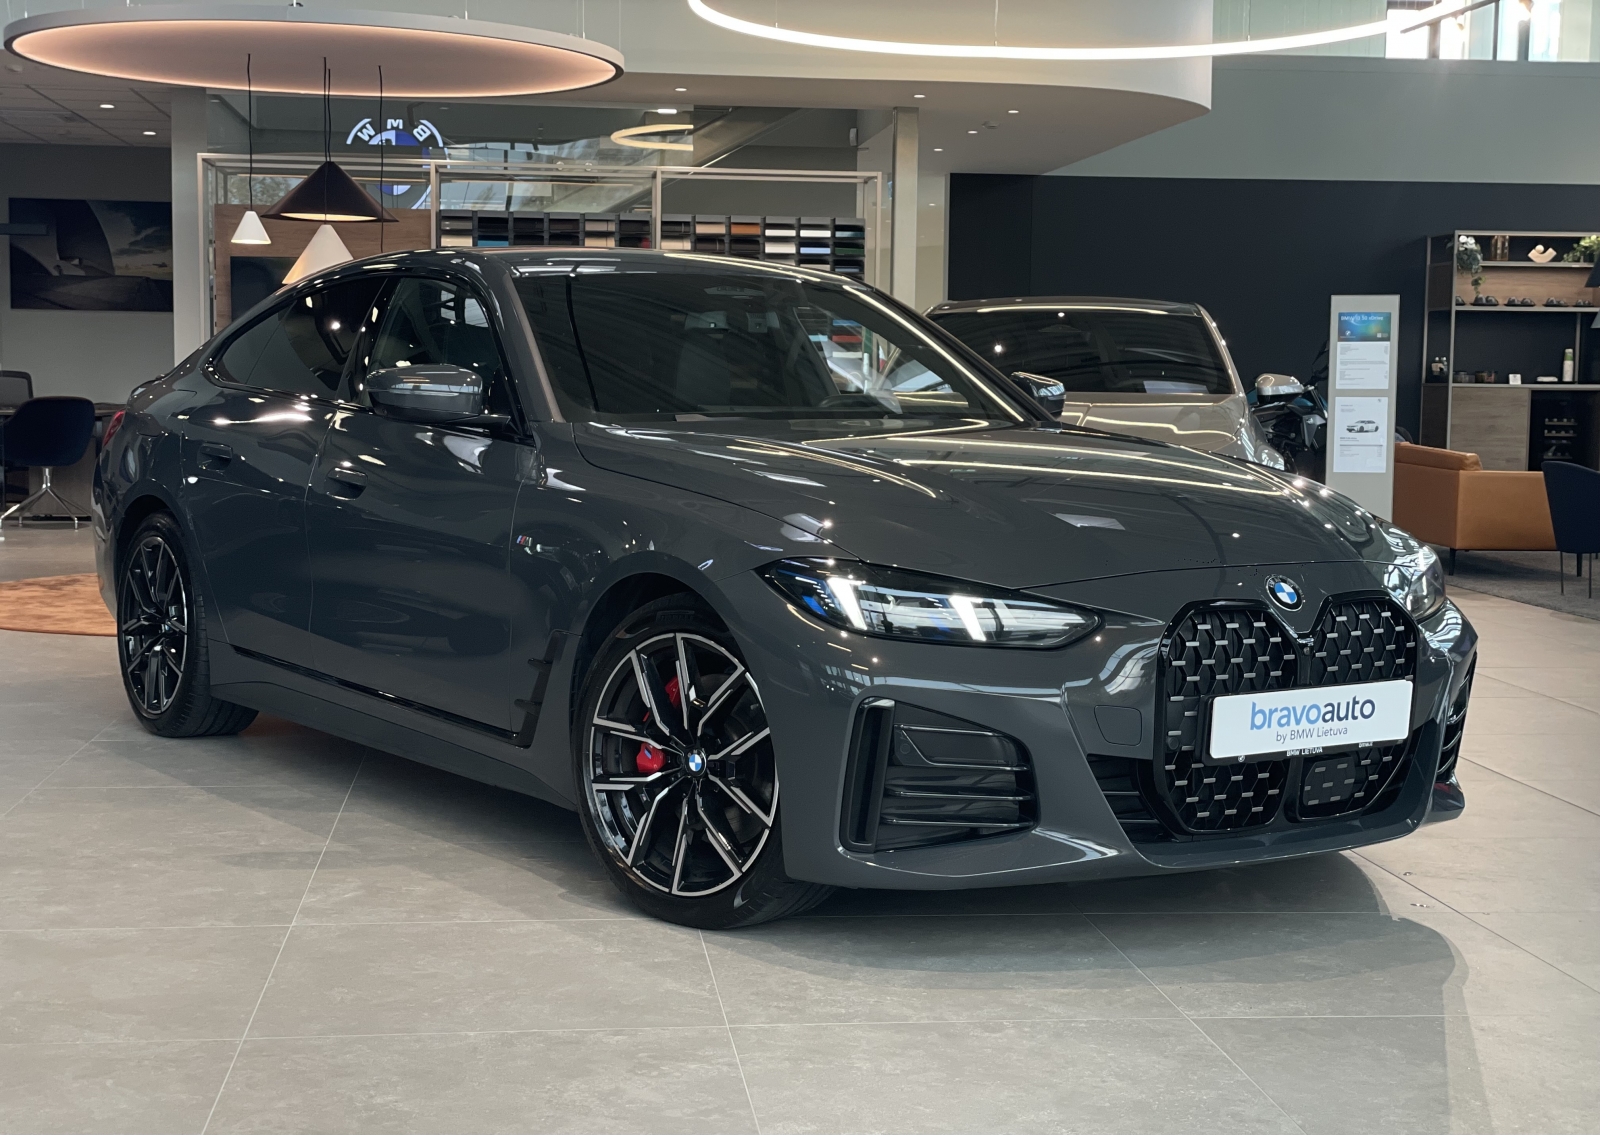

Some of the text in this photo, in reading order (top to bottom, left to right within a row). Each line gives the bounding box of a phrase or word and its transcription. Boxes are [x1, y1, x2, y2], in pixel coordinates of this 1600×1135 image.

[1250, 695, 1376, 731] bravoauto
[1276, 726, 1348, 745] by BMW Lietuva
